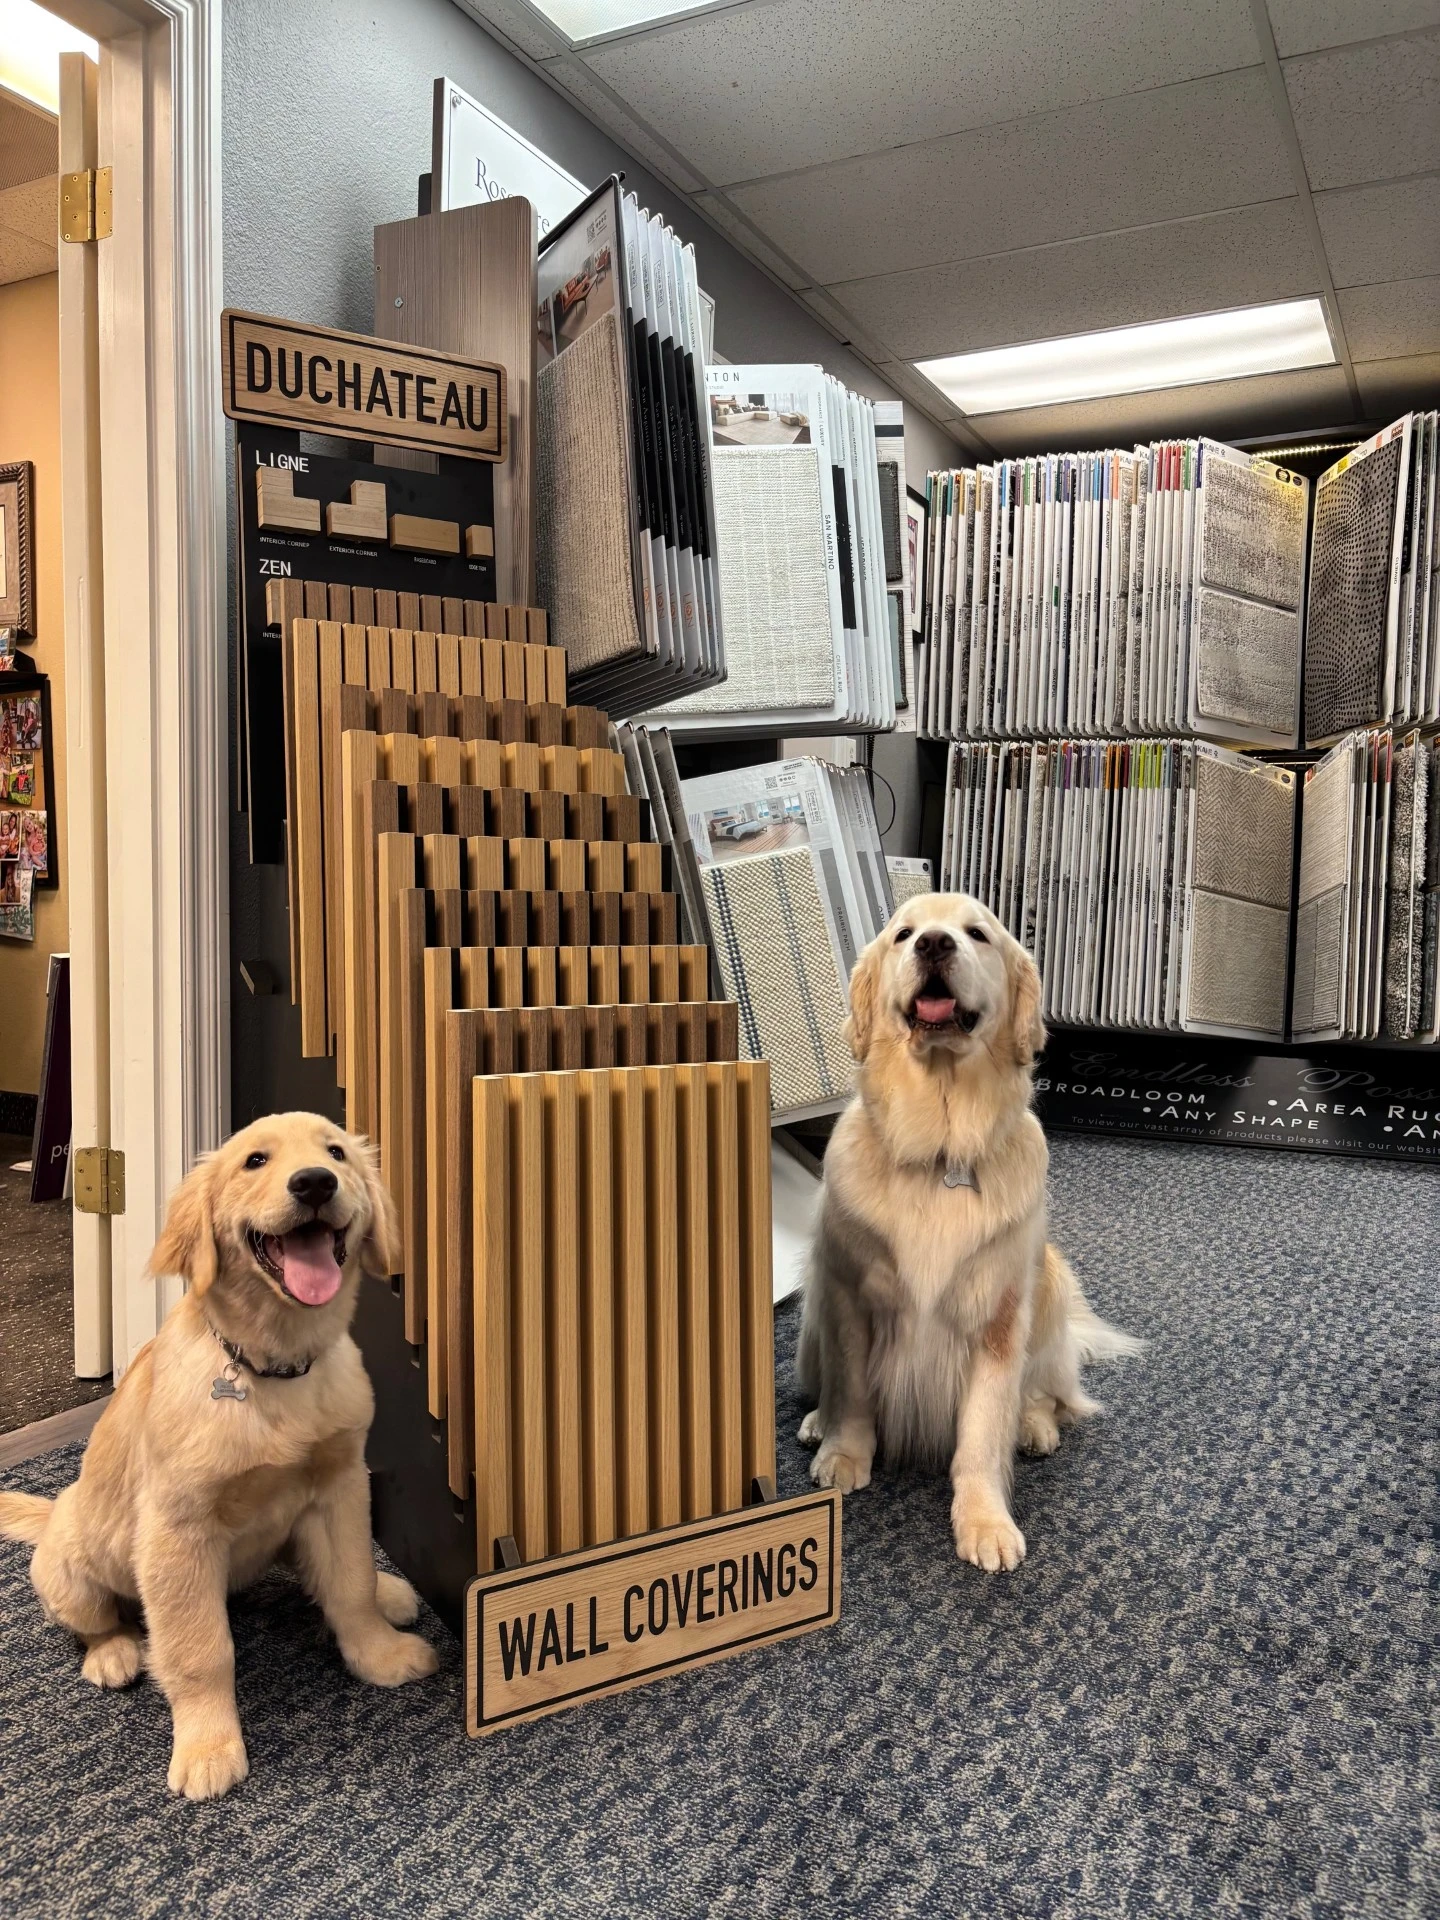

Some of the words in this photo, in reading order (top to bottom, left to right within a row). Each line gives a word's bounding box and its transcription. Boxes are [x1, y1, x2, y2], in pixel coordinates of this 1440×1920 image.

[245, 340, 489, 432] DUCHATEAU
[255, 449, 310, 473] LIGNE
[259, 536, 285, 546] INTERIOR
[286, 540, 310, 549] CORNER
[329, 545, 355, 556] EXTERIOR
[355, 548, 378, 558] CORNER
[826, 533, 835, 570] MARTINO
[258, 558, 292, 577] ZEN
[682, 592, 695, 629] LION
[836, 906, 846, 934] PRAIRIE
[842, 934, 851, 952] PATH
[1069, 1050, 1257, 1089] Endless
[1071, 1116, 1084, 1124] To
[1088, 1118, 1115, 1127] view
[1119, 1121, 1140, 1129] our
[1144, 1123, 1168, 1132] vast
[1173, 1126, 1205, 1136] array
[1209, 1127, 1223, 1137] of
[1227, 1129, 1282, 1144] products
[1287, 1135, 1329, 1146] please
[1334, 1138, 1362, 1149] visit
[1368, 1141, 1391, 1150] our
[499, 1596, 609, 1681] WALL
[623, 1537, 818, 1644] COVERINGS
